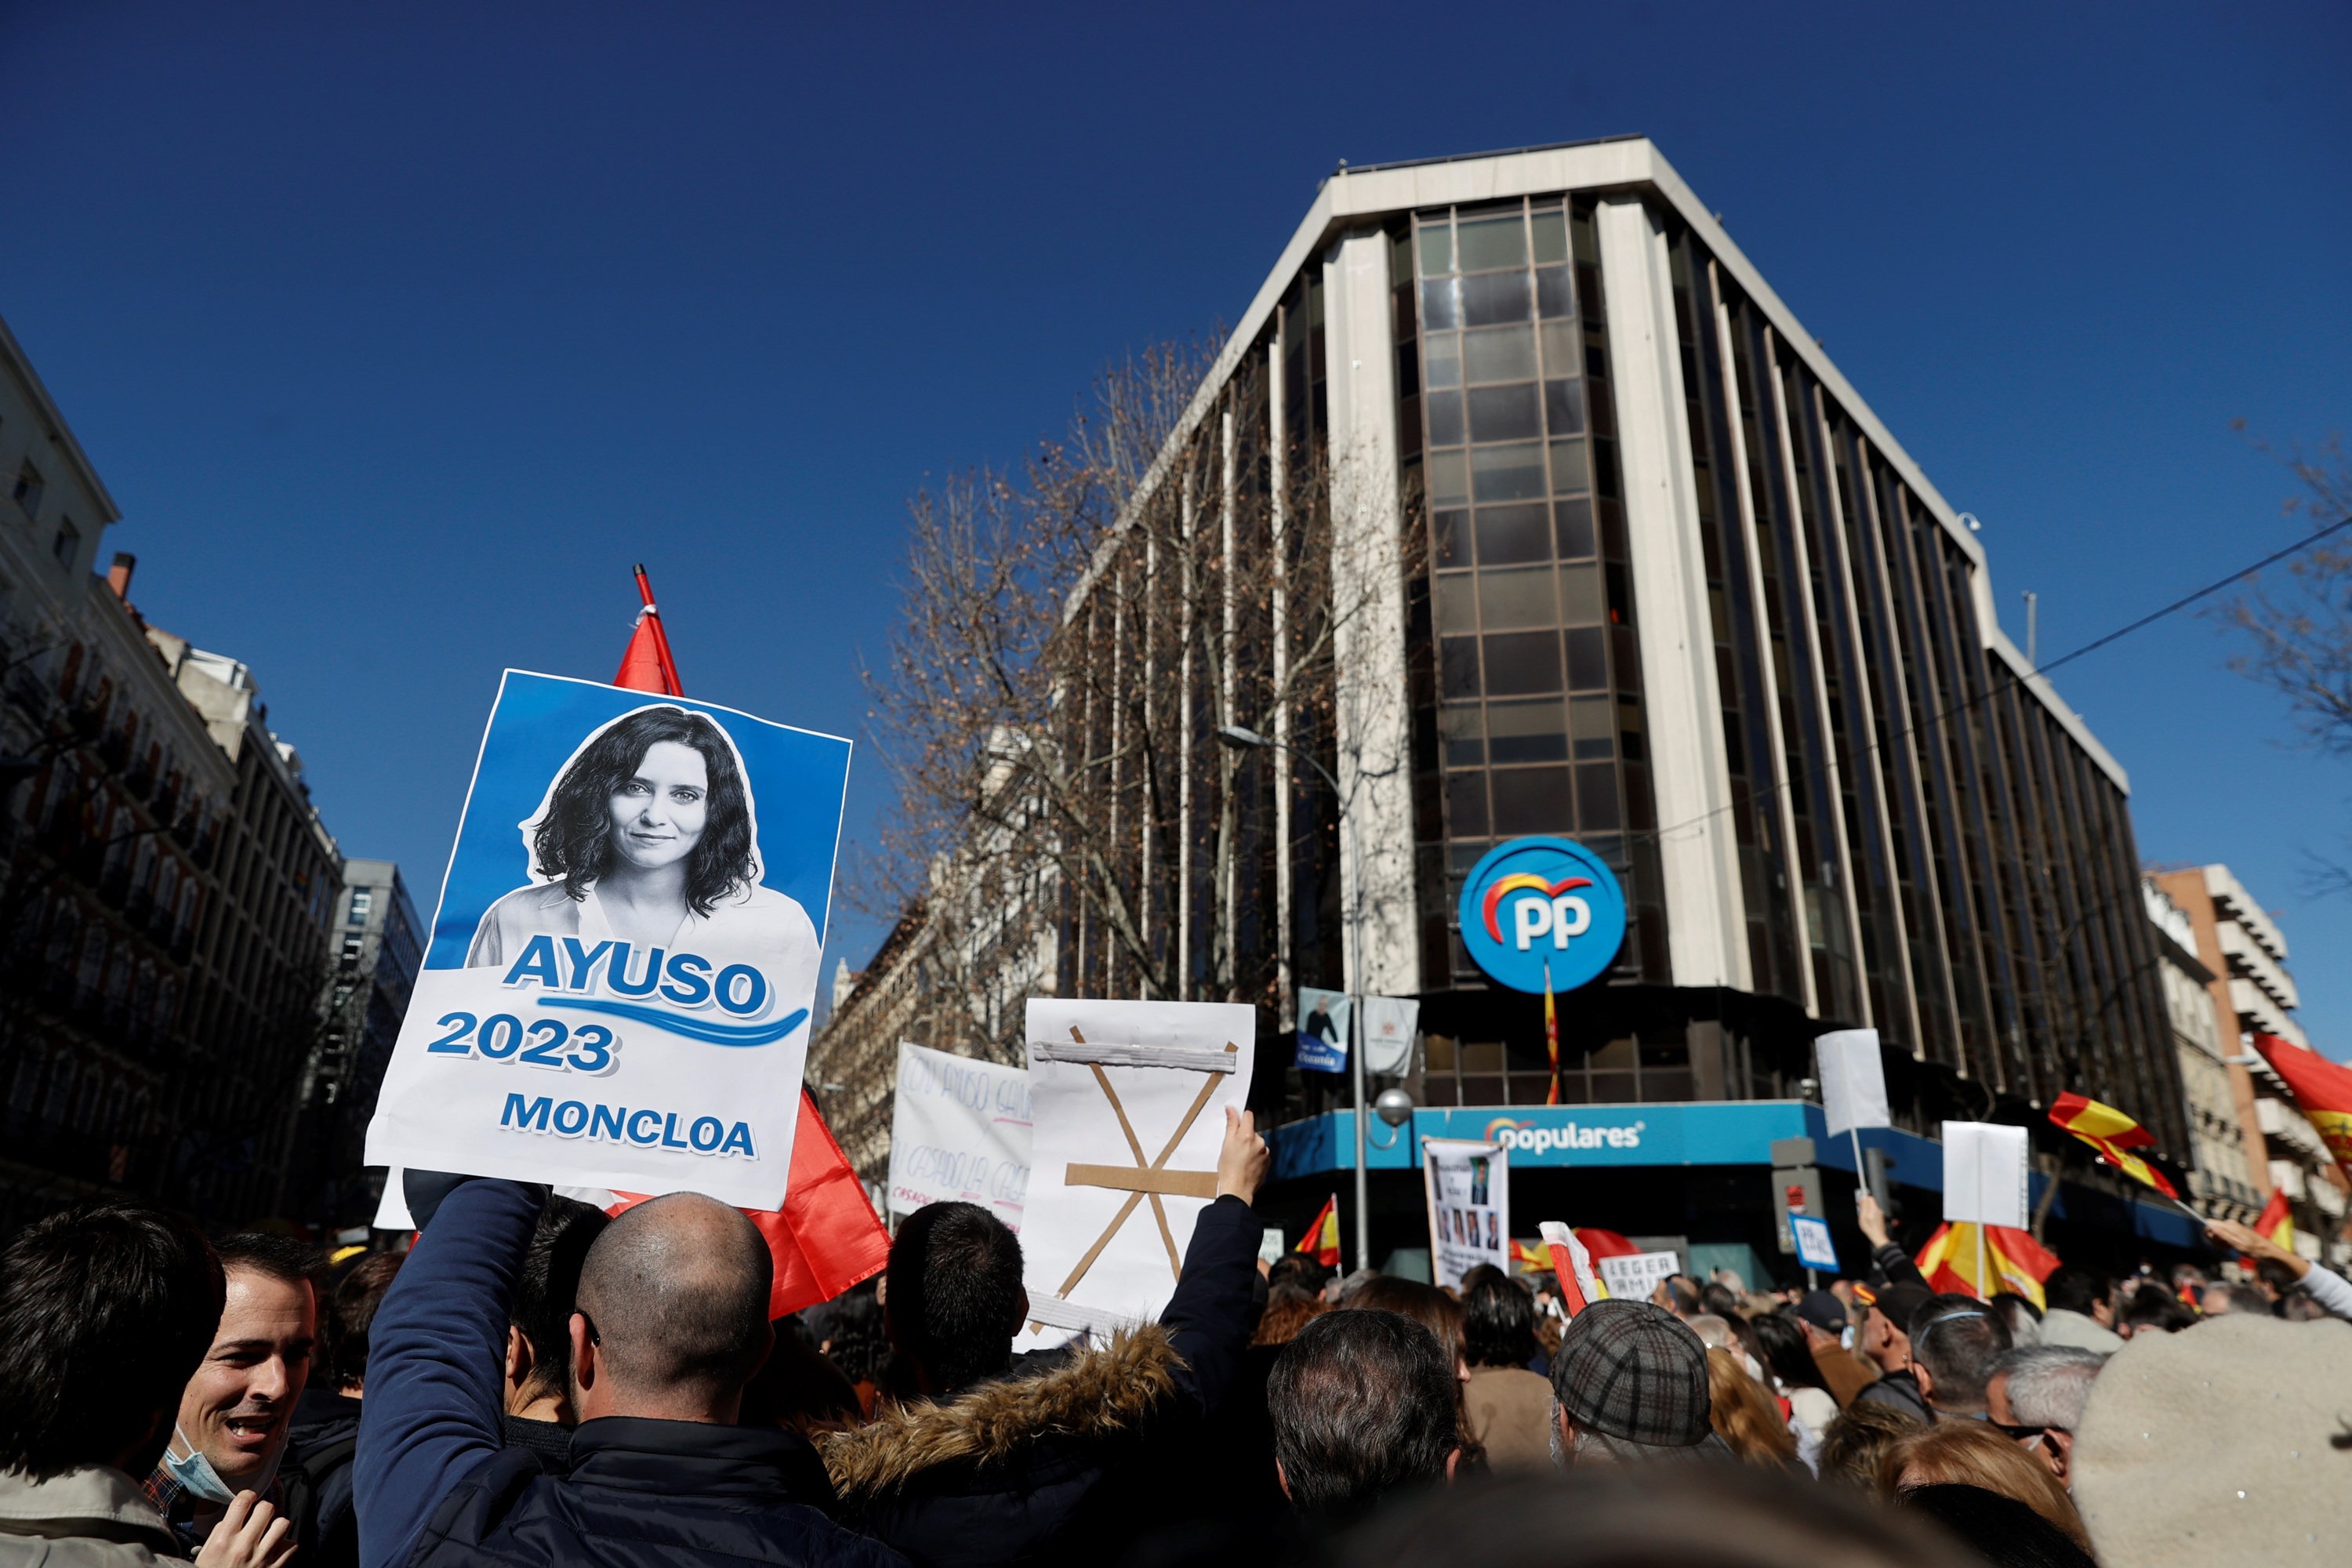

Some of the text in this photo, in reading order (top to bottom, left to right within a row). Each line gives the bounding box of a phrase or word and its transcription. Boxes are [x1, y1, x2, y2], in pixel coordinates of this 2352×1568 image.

[502, 933, 768, 1017] AYUSO
[426, 1011, 613, 1073] 2023
[942, 1062, 991, 1112] AYUSO
[499, 1091, 756, 1158] MONCLOA
[1499, 1122, 1640, 1156] populares
[907, 1144, 967, 1189] CASADO
